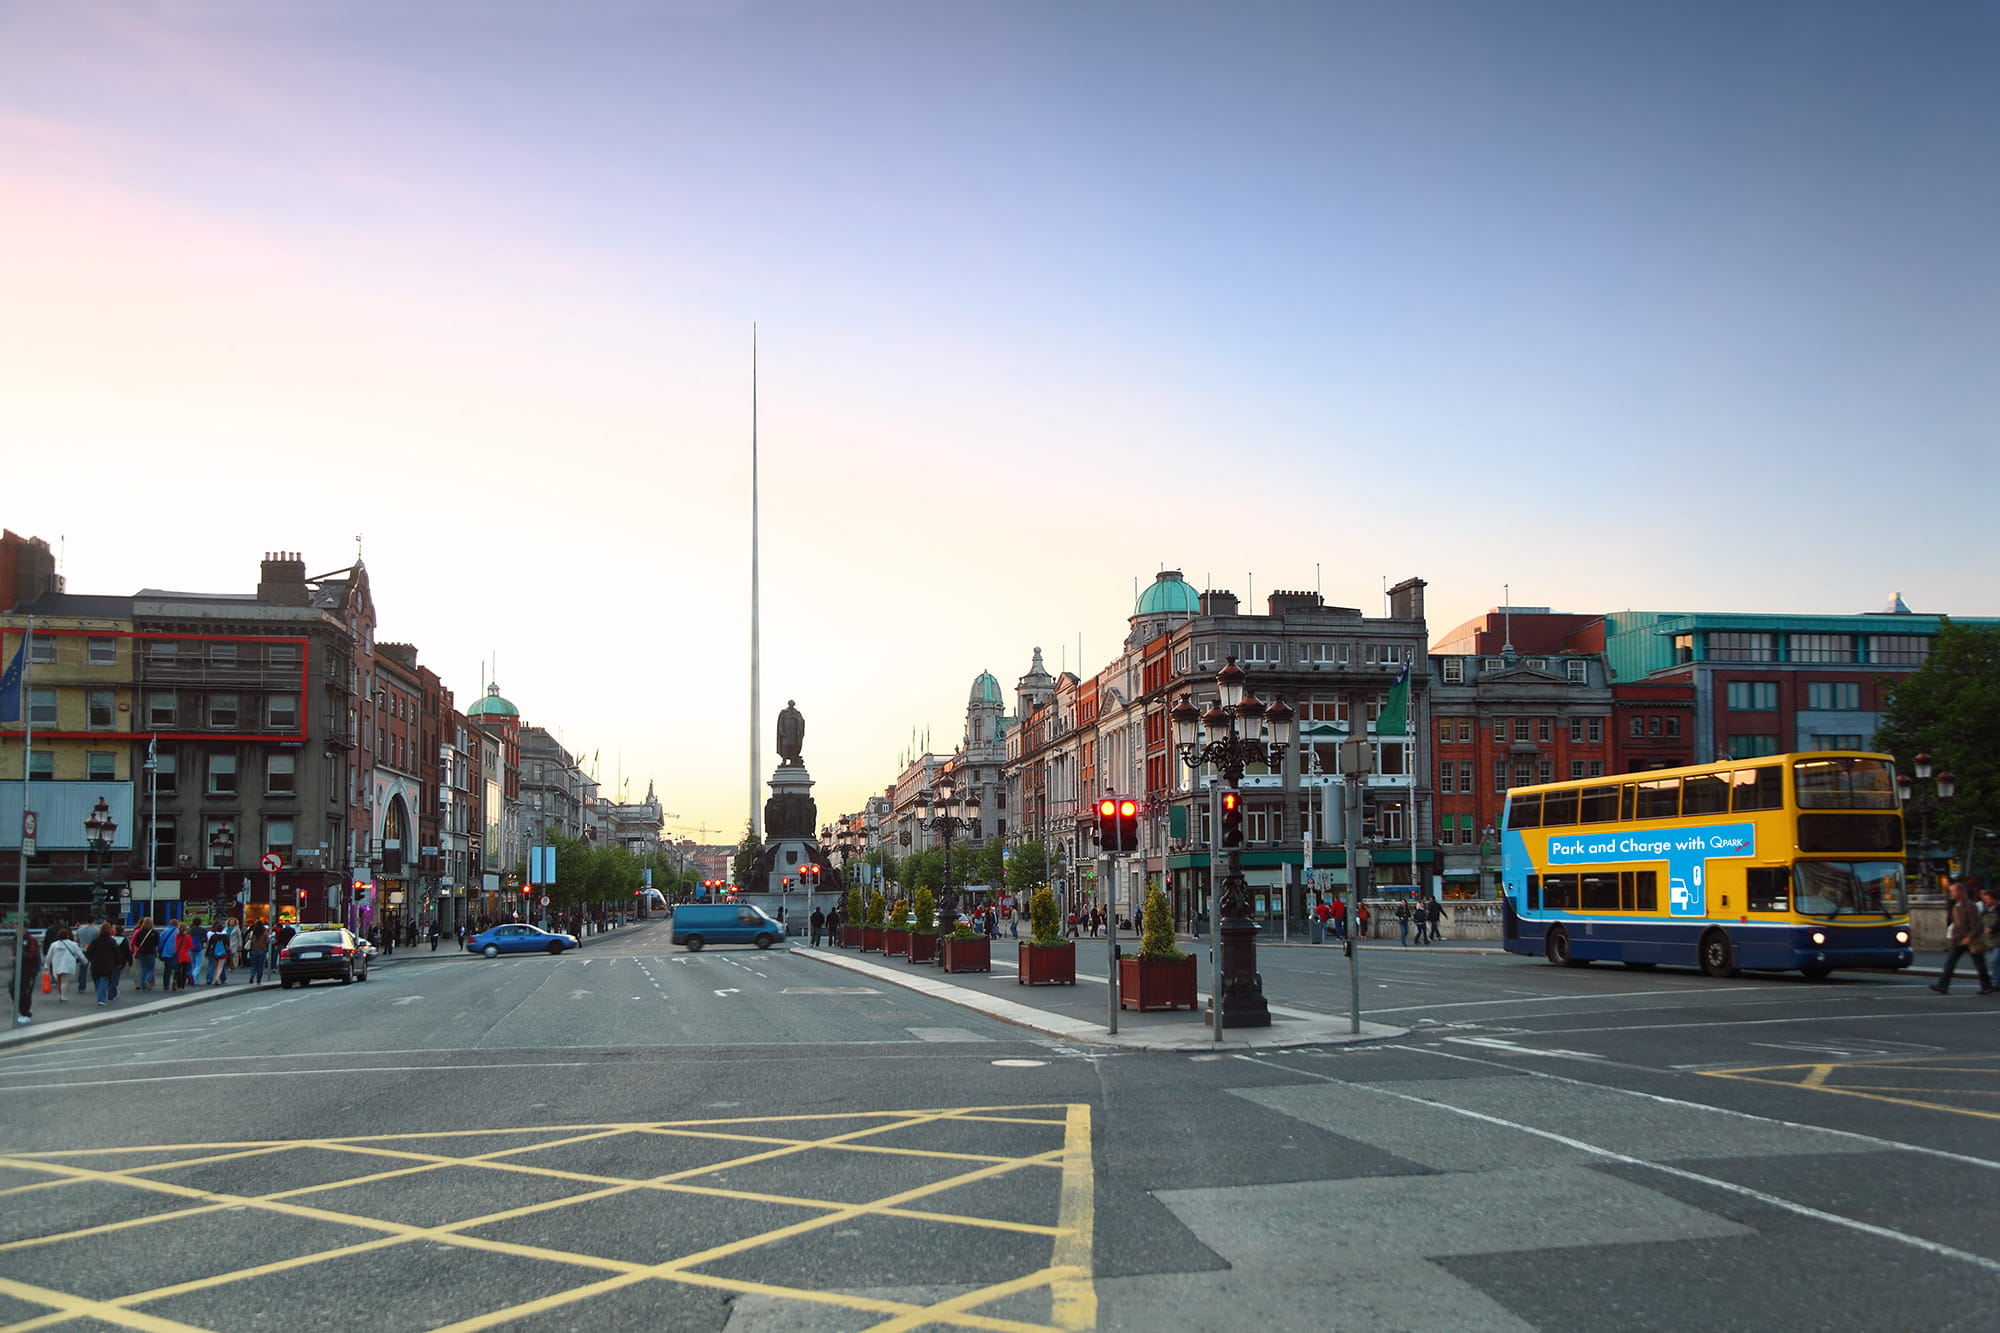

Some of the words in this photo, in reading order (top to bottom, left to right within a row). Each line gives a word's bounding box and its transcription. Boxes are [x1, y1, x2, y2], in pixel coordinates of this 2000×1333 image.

[1552, 840, 1585, 855] Park
[1588, 839, 1616, 854] and
[1619, 837, 1672, 855] Charge
[1675, 836, 1706, 851] with
